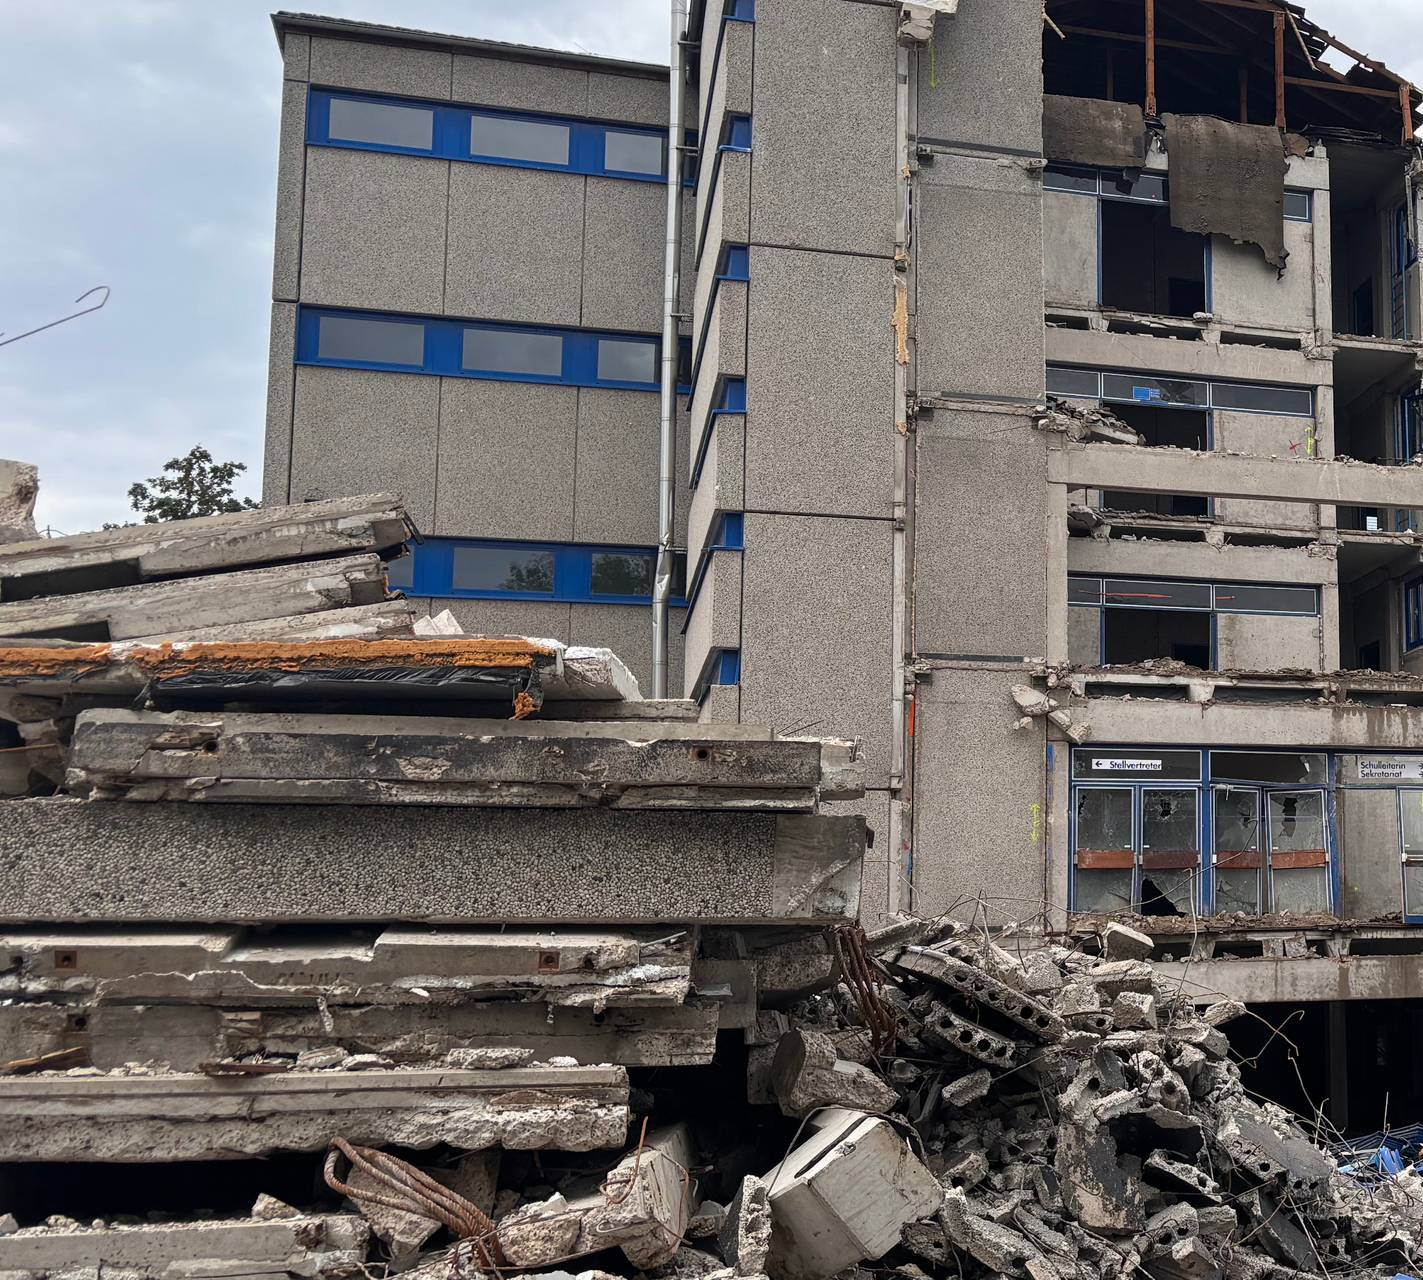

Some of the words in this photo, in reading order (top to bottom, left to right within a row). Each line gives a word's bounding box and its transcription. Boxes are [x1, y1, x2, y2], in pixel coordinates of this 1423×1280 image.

[1109, 760, 1161, 769] Stellvertreter
[1361, 761, 1406, 770] Schulleiterin
[1361, 769, 1402, 778] Sekretariat
